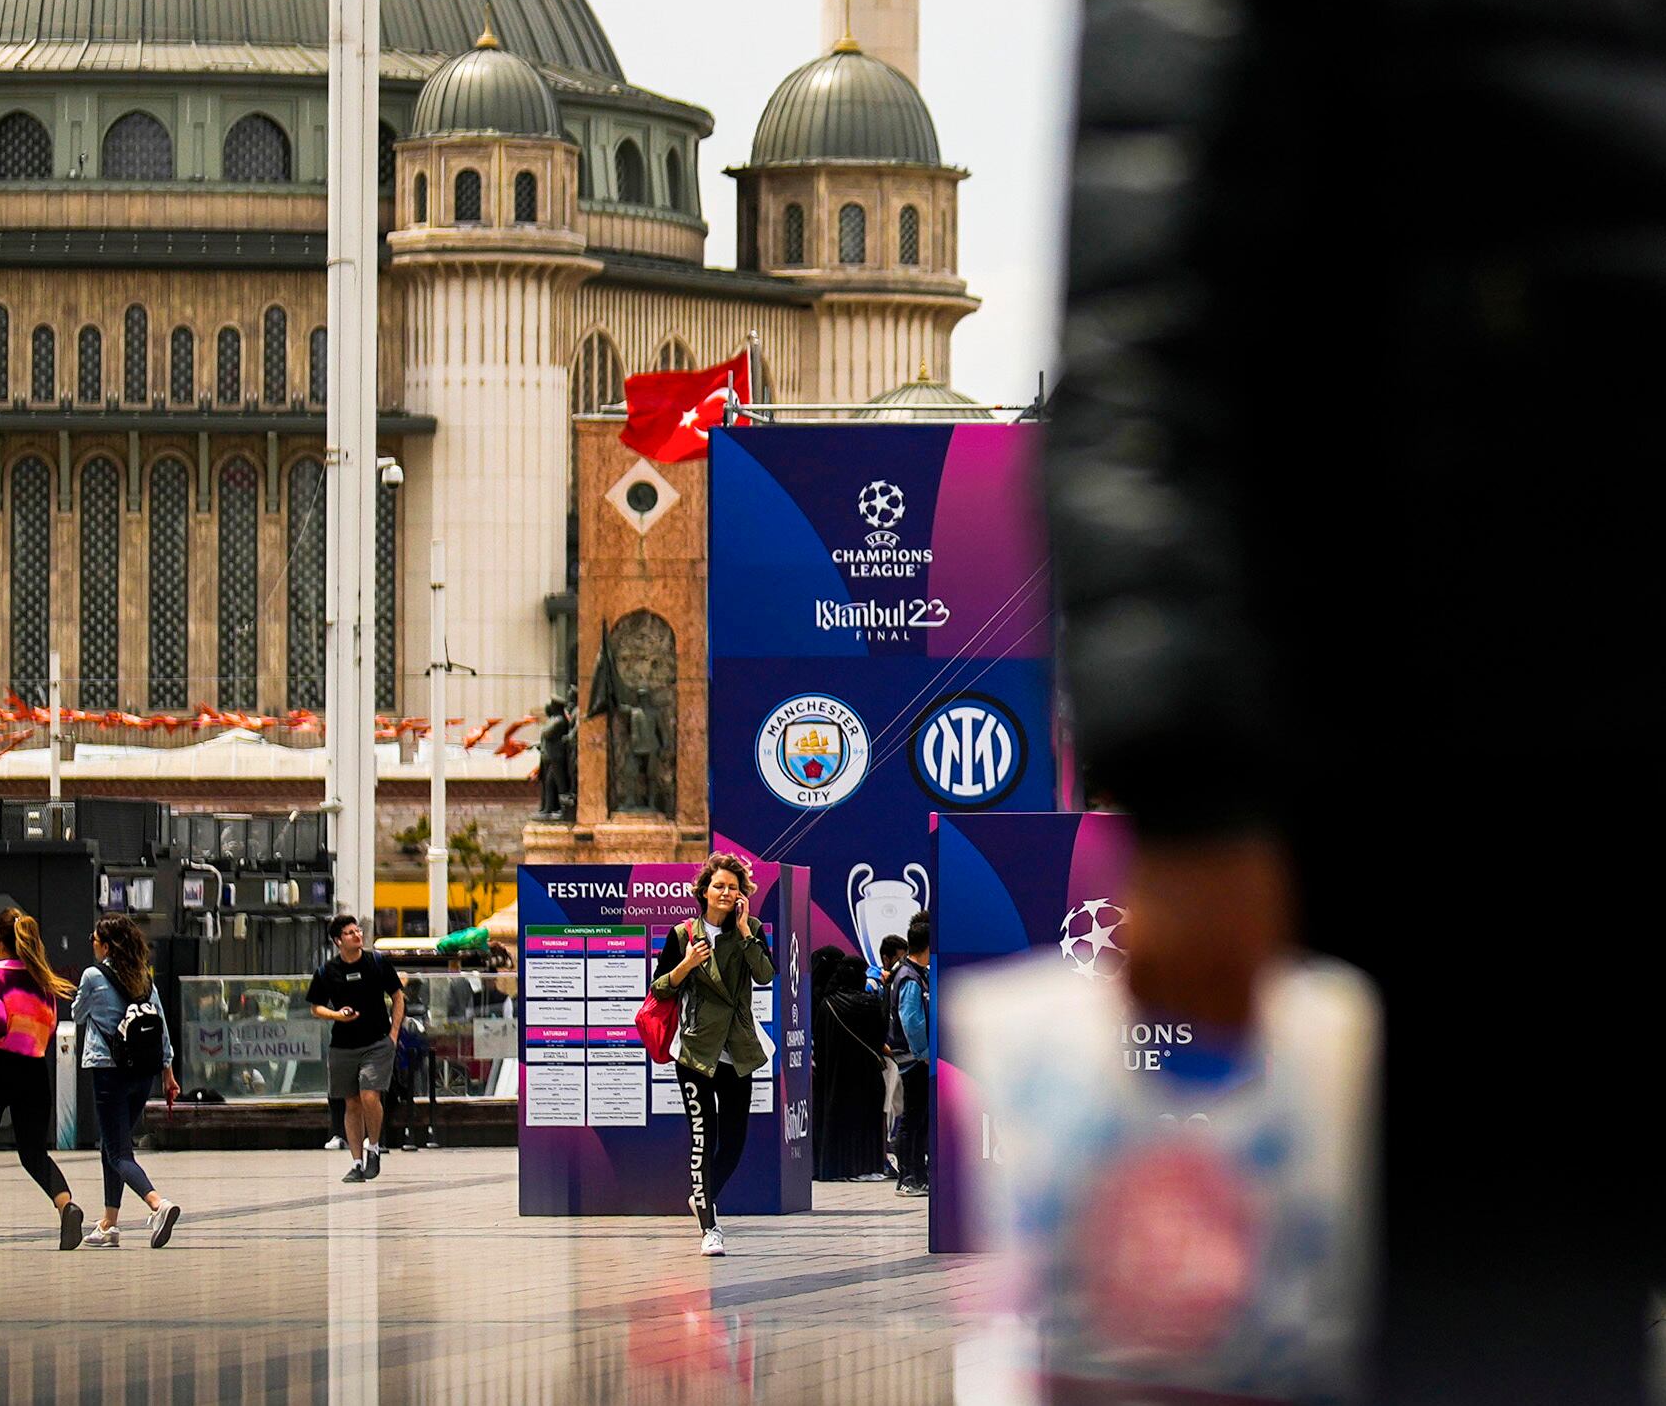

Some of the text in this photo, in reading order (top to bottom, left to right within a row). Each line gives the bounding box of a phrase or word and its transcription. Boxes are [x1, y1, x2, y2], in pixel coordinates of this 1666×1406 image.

[866, 532, 898, 546] UEFA
[832, 549, 933, 563] CHAMPIONS
[850, 564, 916, 577] LEAGUE
[855, 631, 910, 641] FINAL
[767, 700, 860, 738] MANCHESTER
[797, 791, 832, 803] CITY
[547, 882, 694, 899] FESTIVAL PROGR
[600, 905, 697, 917] Doors Open: 11:00am
[228, 1025, 288, 1040] METRO
[685, 1081, 707, 1209] CONFIDENT
